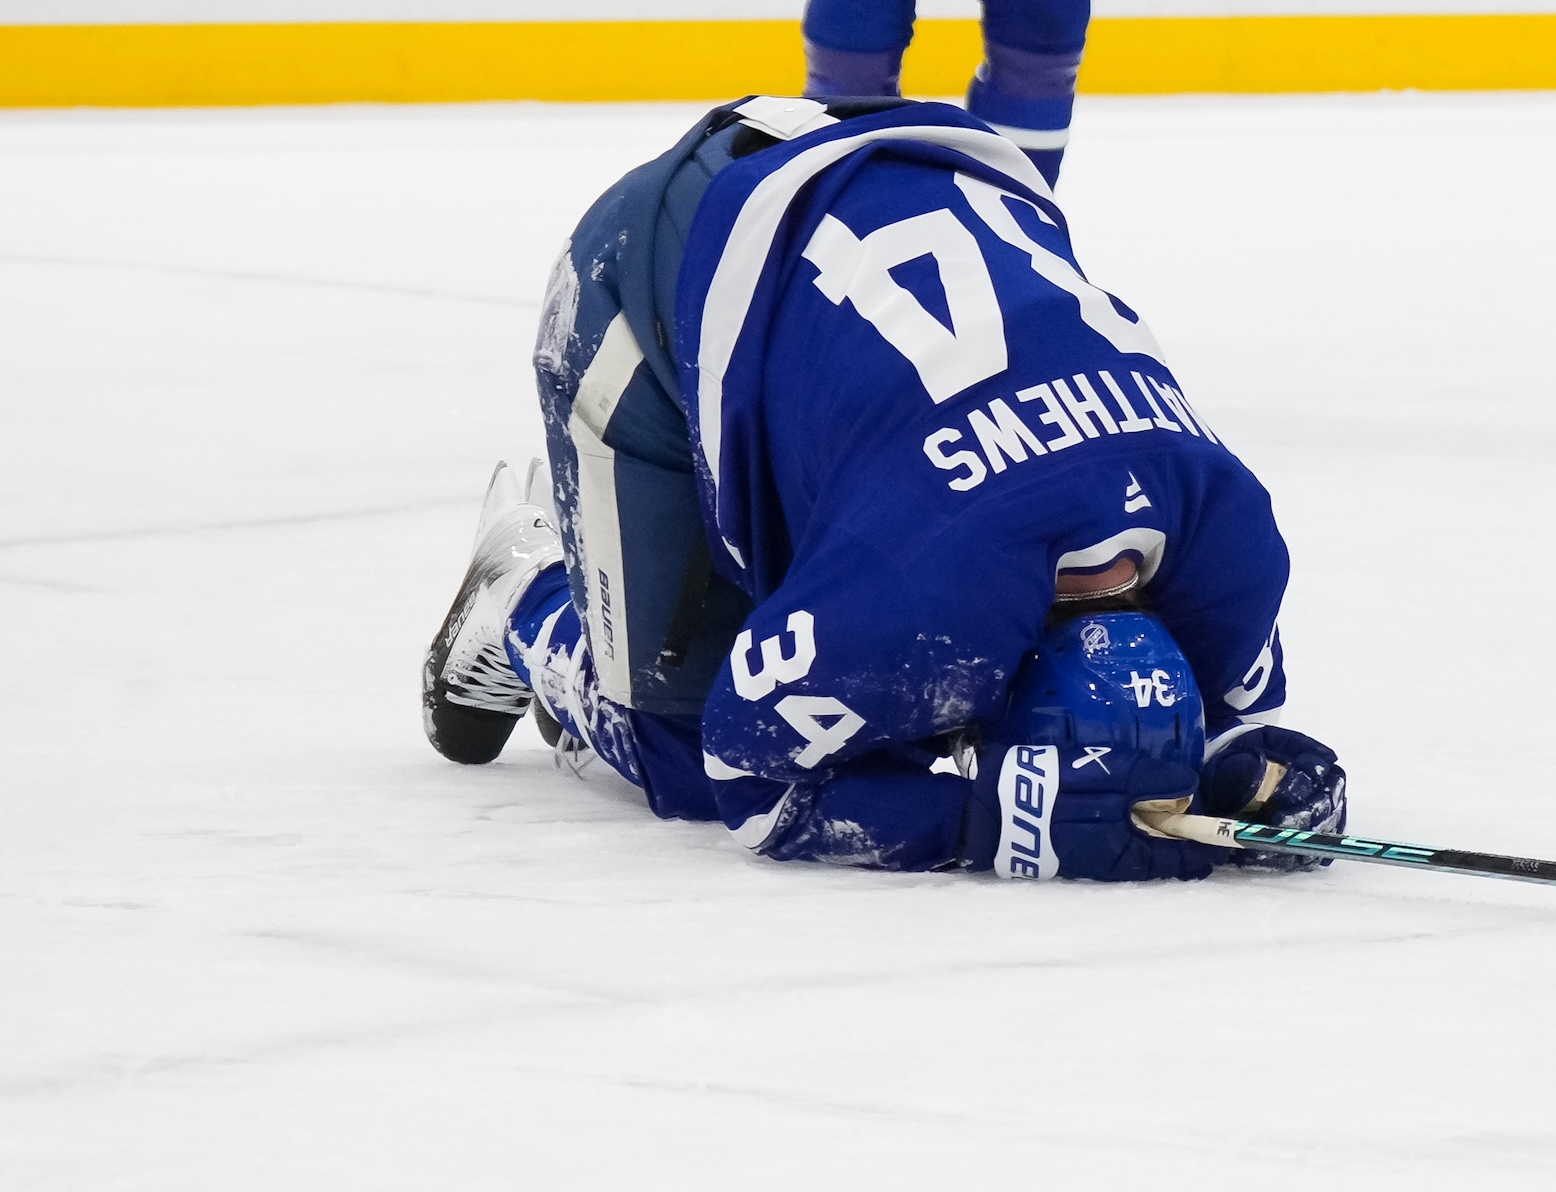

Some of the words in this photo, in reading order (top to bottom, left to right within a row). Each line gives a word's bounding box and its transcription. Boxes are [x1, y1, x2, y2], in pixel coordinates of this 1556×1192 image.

[598, 568, 615, 662] BAUER
[730, 610, 867, 769] 34
[1126, 669, 1175, 708] 34
[1010, 746, 1046, 879] AUER
